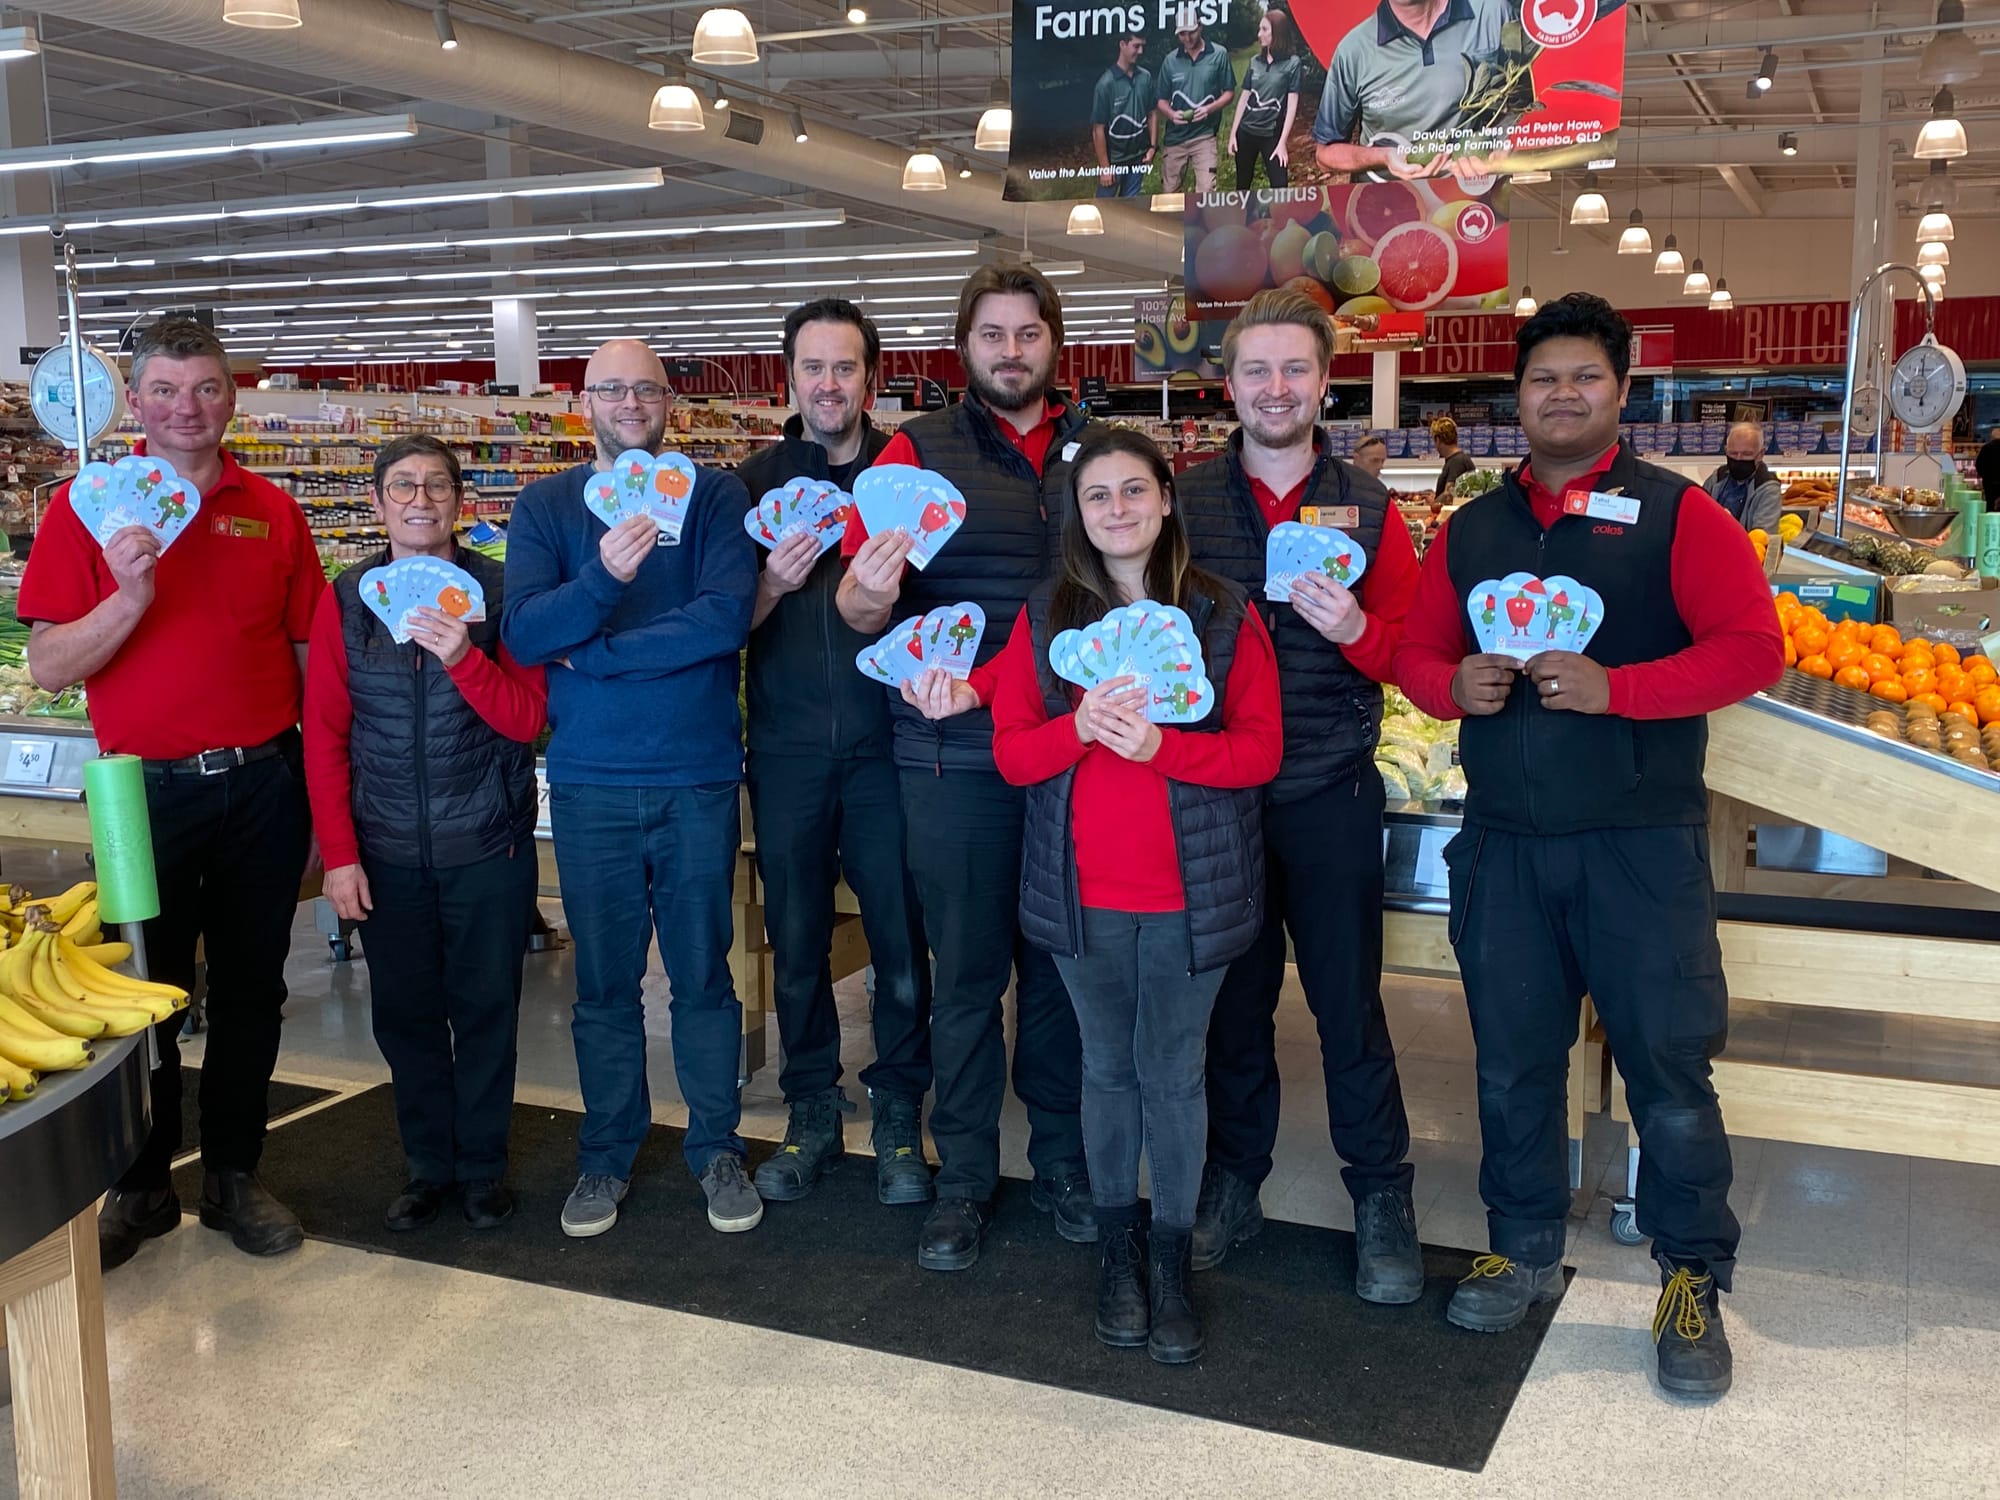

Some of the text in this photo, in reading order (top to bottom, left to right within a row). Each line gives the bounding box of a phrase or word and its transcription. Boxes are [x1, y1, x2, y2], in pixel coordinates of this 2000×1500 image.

[1035, 0, 1233, 40] Farms First
[1536, 27, 1580, 44] FARMS FIRST
[1412, 119, 1603, 142] David, Tom, Jess and Peter Howe,
[1397, 132, 1602, 155] Rock Ridge Farming, Mareeba, QLD
[1028, 164, 1154, 180] Value the Australian way
[1196, 186, 1318, 210] Juicy Citrus
[1142, 301, 1169, 312] 100%
[1140, 314, 1187, 324] Hass Avo
[1592, 524, 1624, 536] coles
